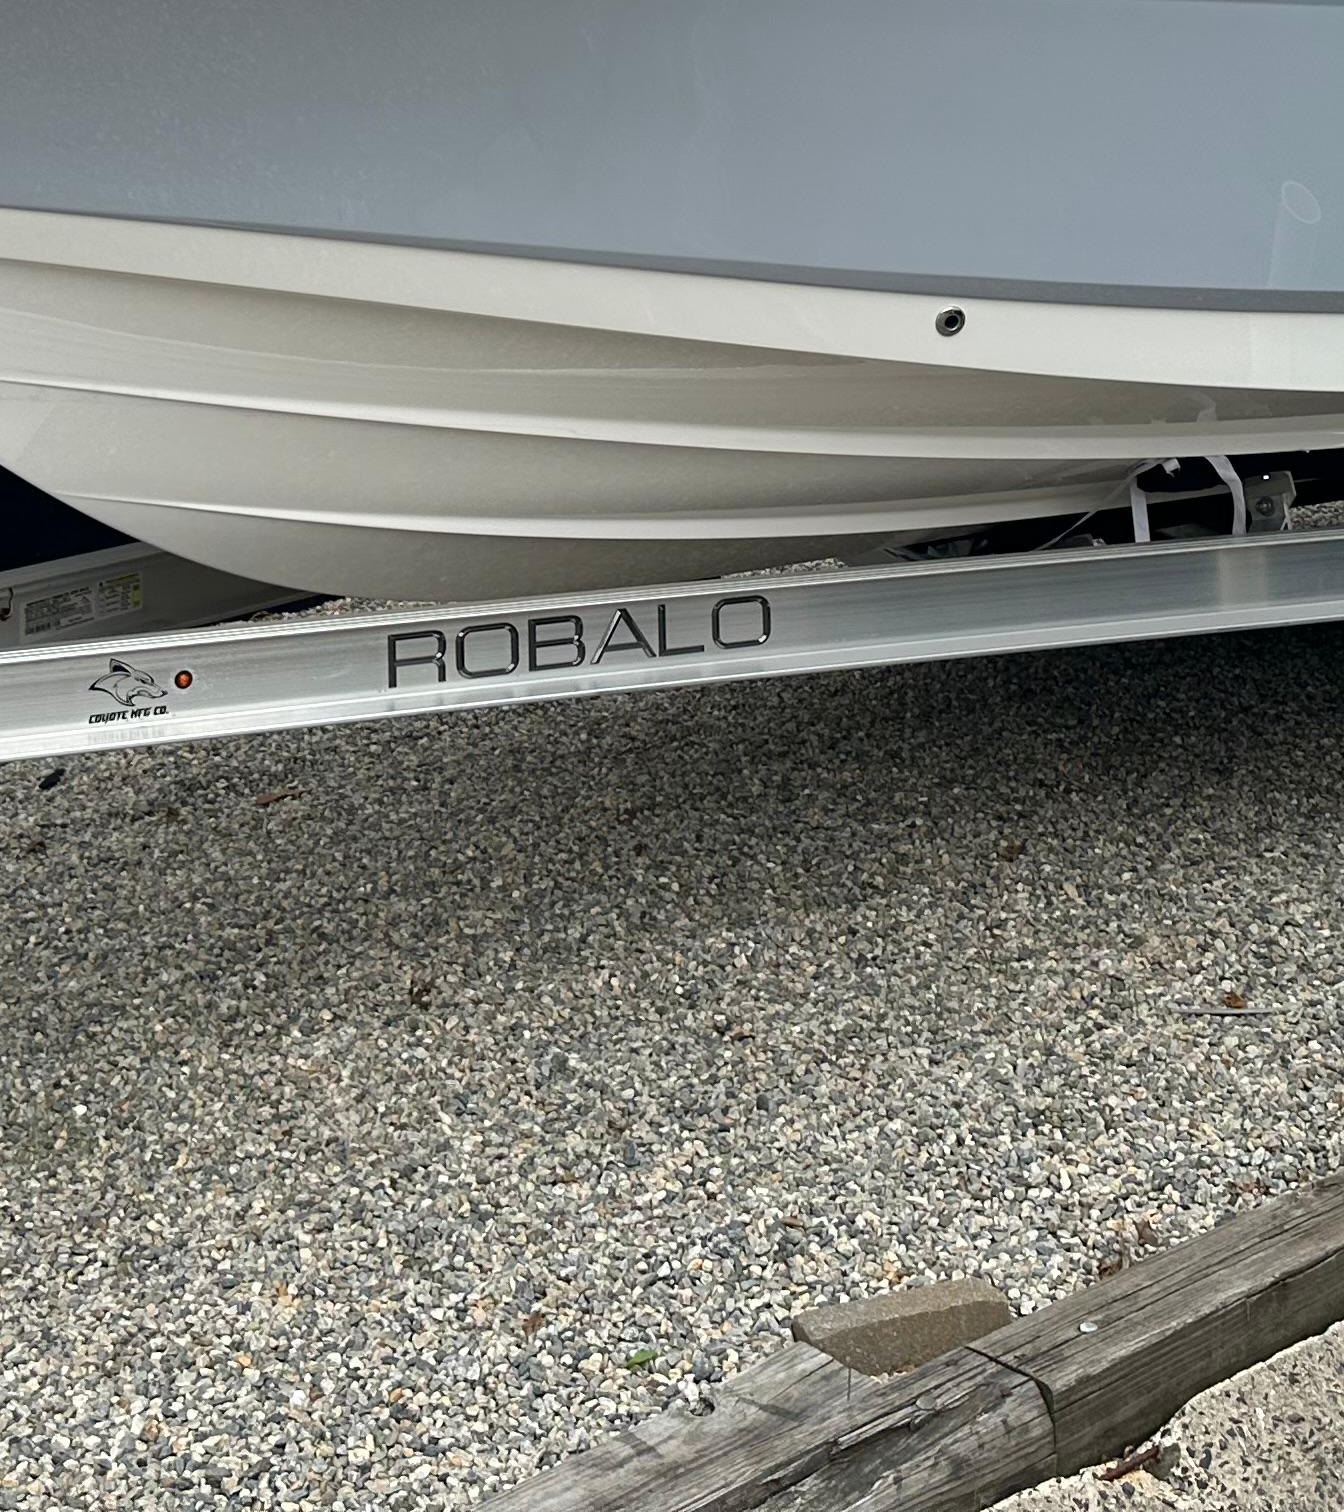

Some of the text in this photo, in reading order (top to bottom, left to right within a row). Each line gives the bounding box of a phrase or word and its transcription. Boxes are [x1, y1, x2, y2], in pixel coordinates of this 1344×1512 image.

[387, 594, 772, 689] ROBALO
[88, 710, 130, 724] COYOTE
[153, 705, 170, 716] CO.
